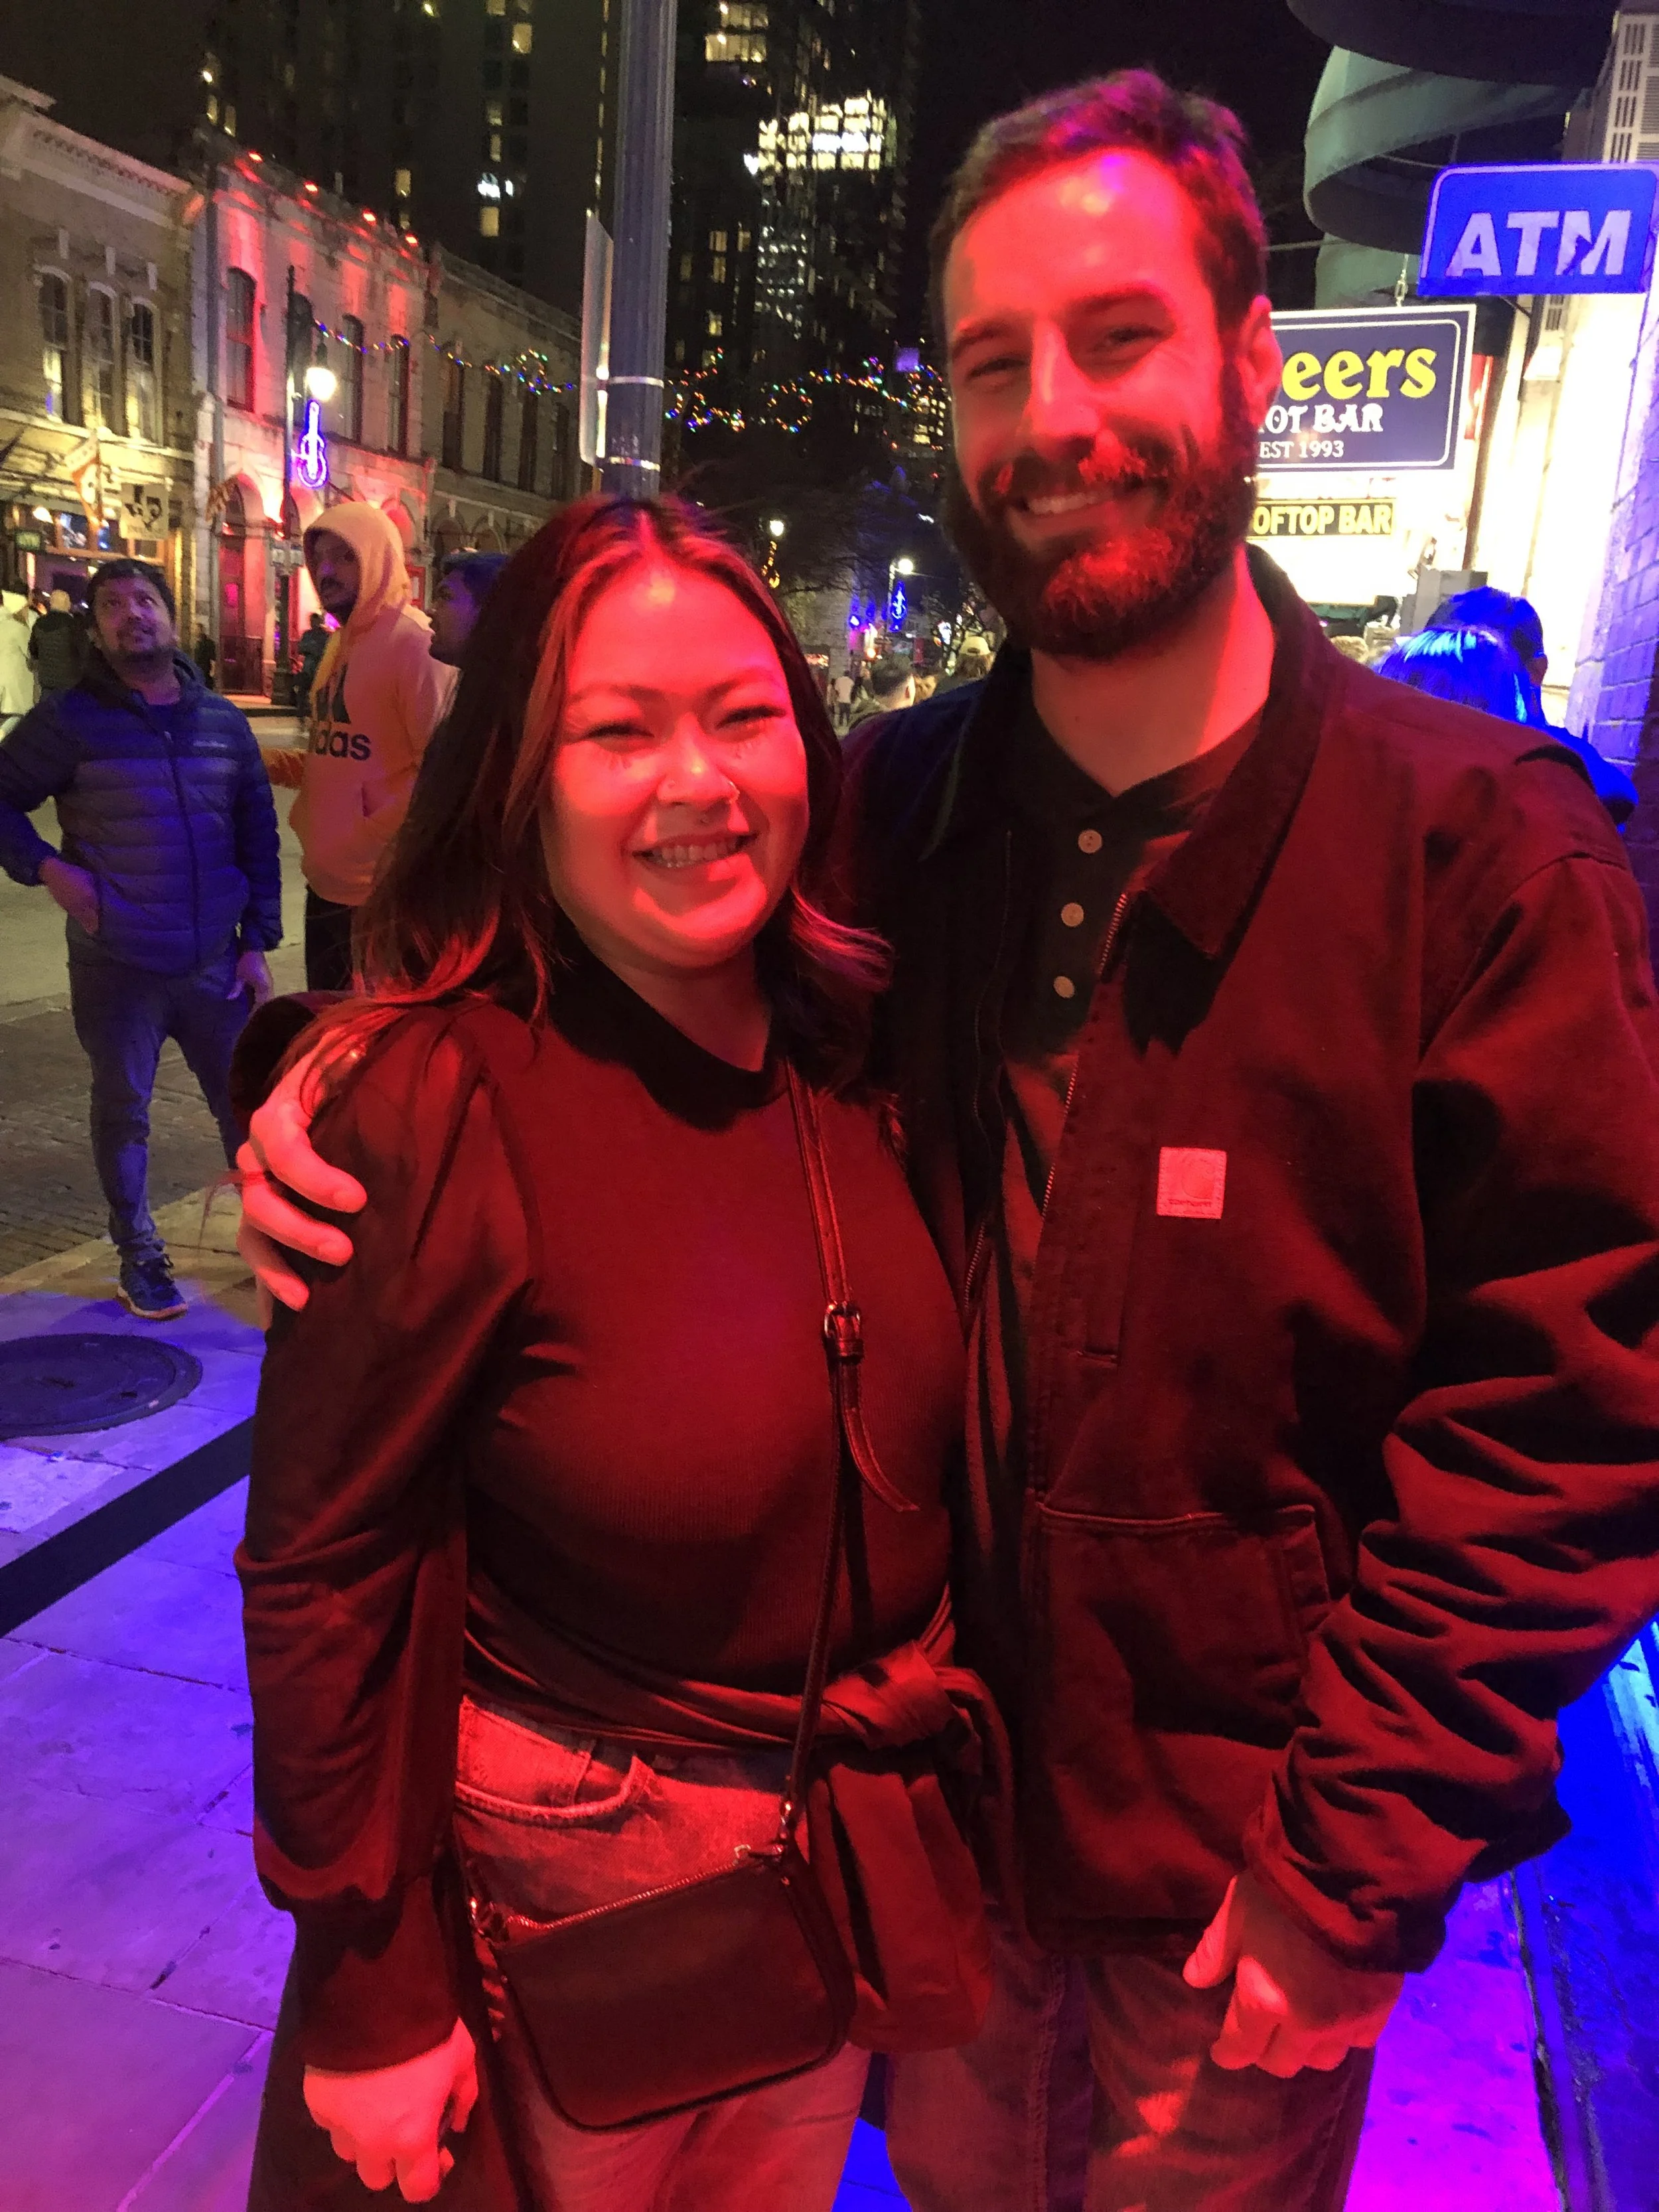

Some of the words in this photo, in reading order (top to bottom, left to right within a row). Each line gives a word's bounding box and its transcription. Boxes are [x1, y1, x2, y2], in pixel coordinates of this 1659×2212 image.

[1445, 210, 1632, 277] ATM
[1282, 348, 1436, 400] eers
[1313, 403, 1384, 433] BAR
[1259, 441, 1295, 459] EST
[1299, 440, 1344, 458] 1993
[1252, 505, 1334, 534] OFTOP
[1338, 504, 1392, 534] BAR
